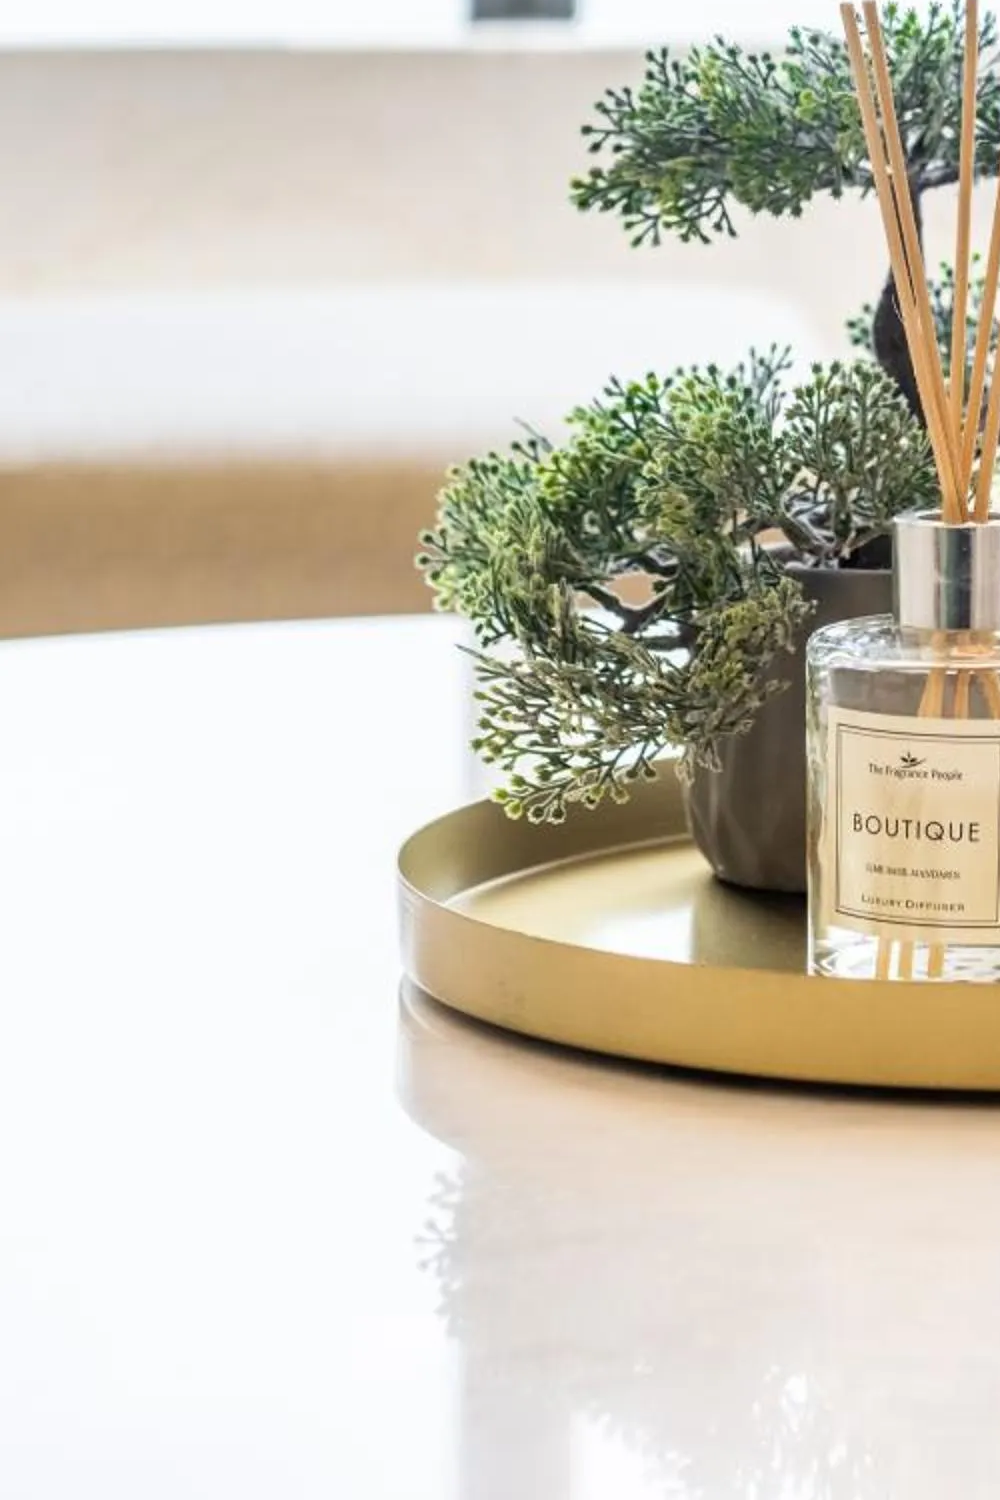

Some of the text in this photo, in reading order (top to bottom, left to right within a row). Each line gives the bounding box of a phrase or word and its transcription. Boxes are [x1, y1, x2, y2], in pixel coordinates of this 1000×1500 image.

[869, 762, 963, 781] The Fragrance People
[852, 812, 981, 843] BOUTIQUE
[861, 892, 965, 912] LUXURY DIFFUSER
